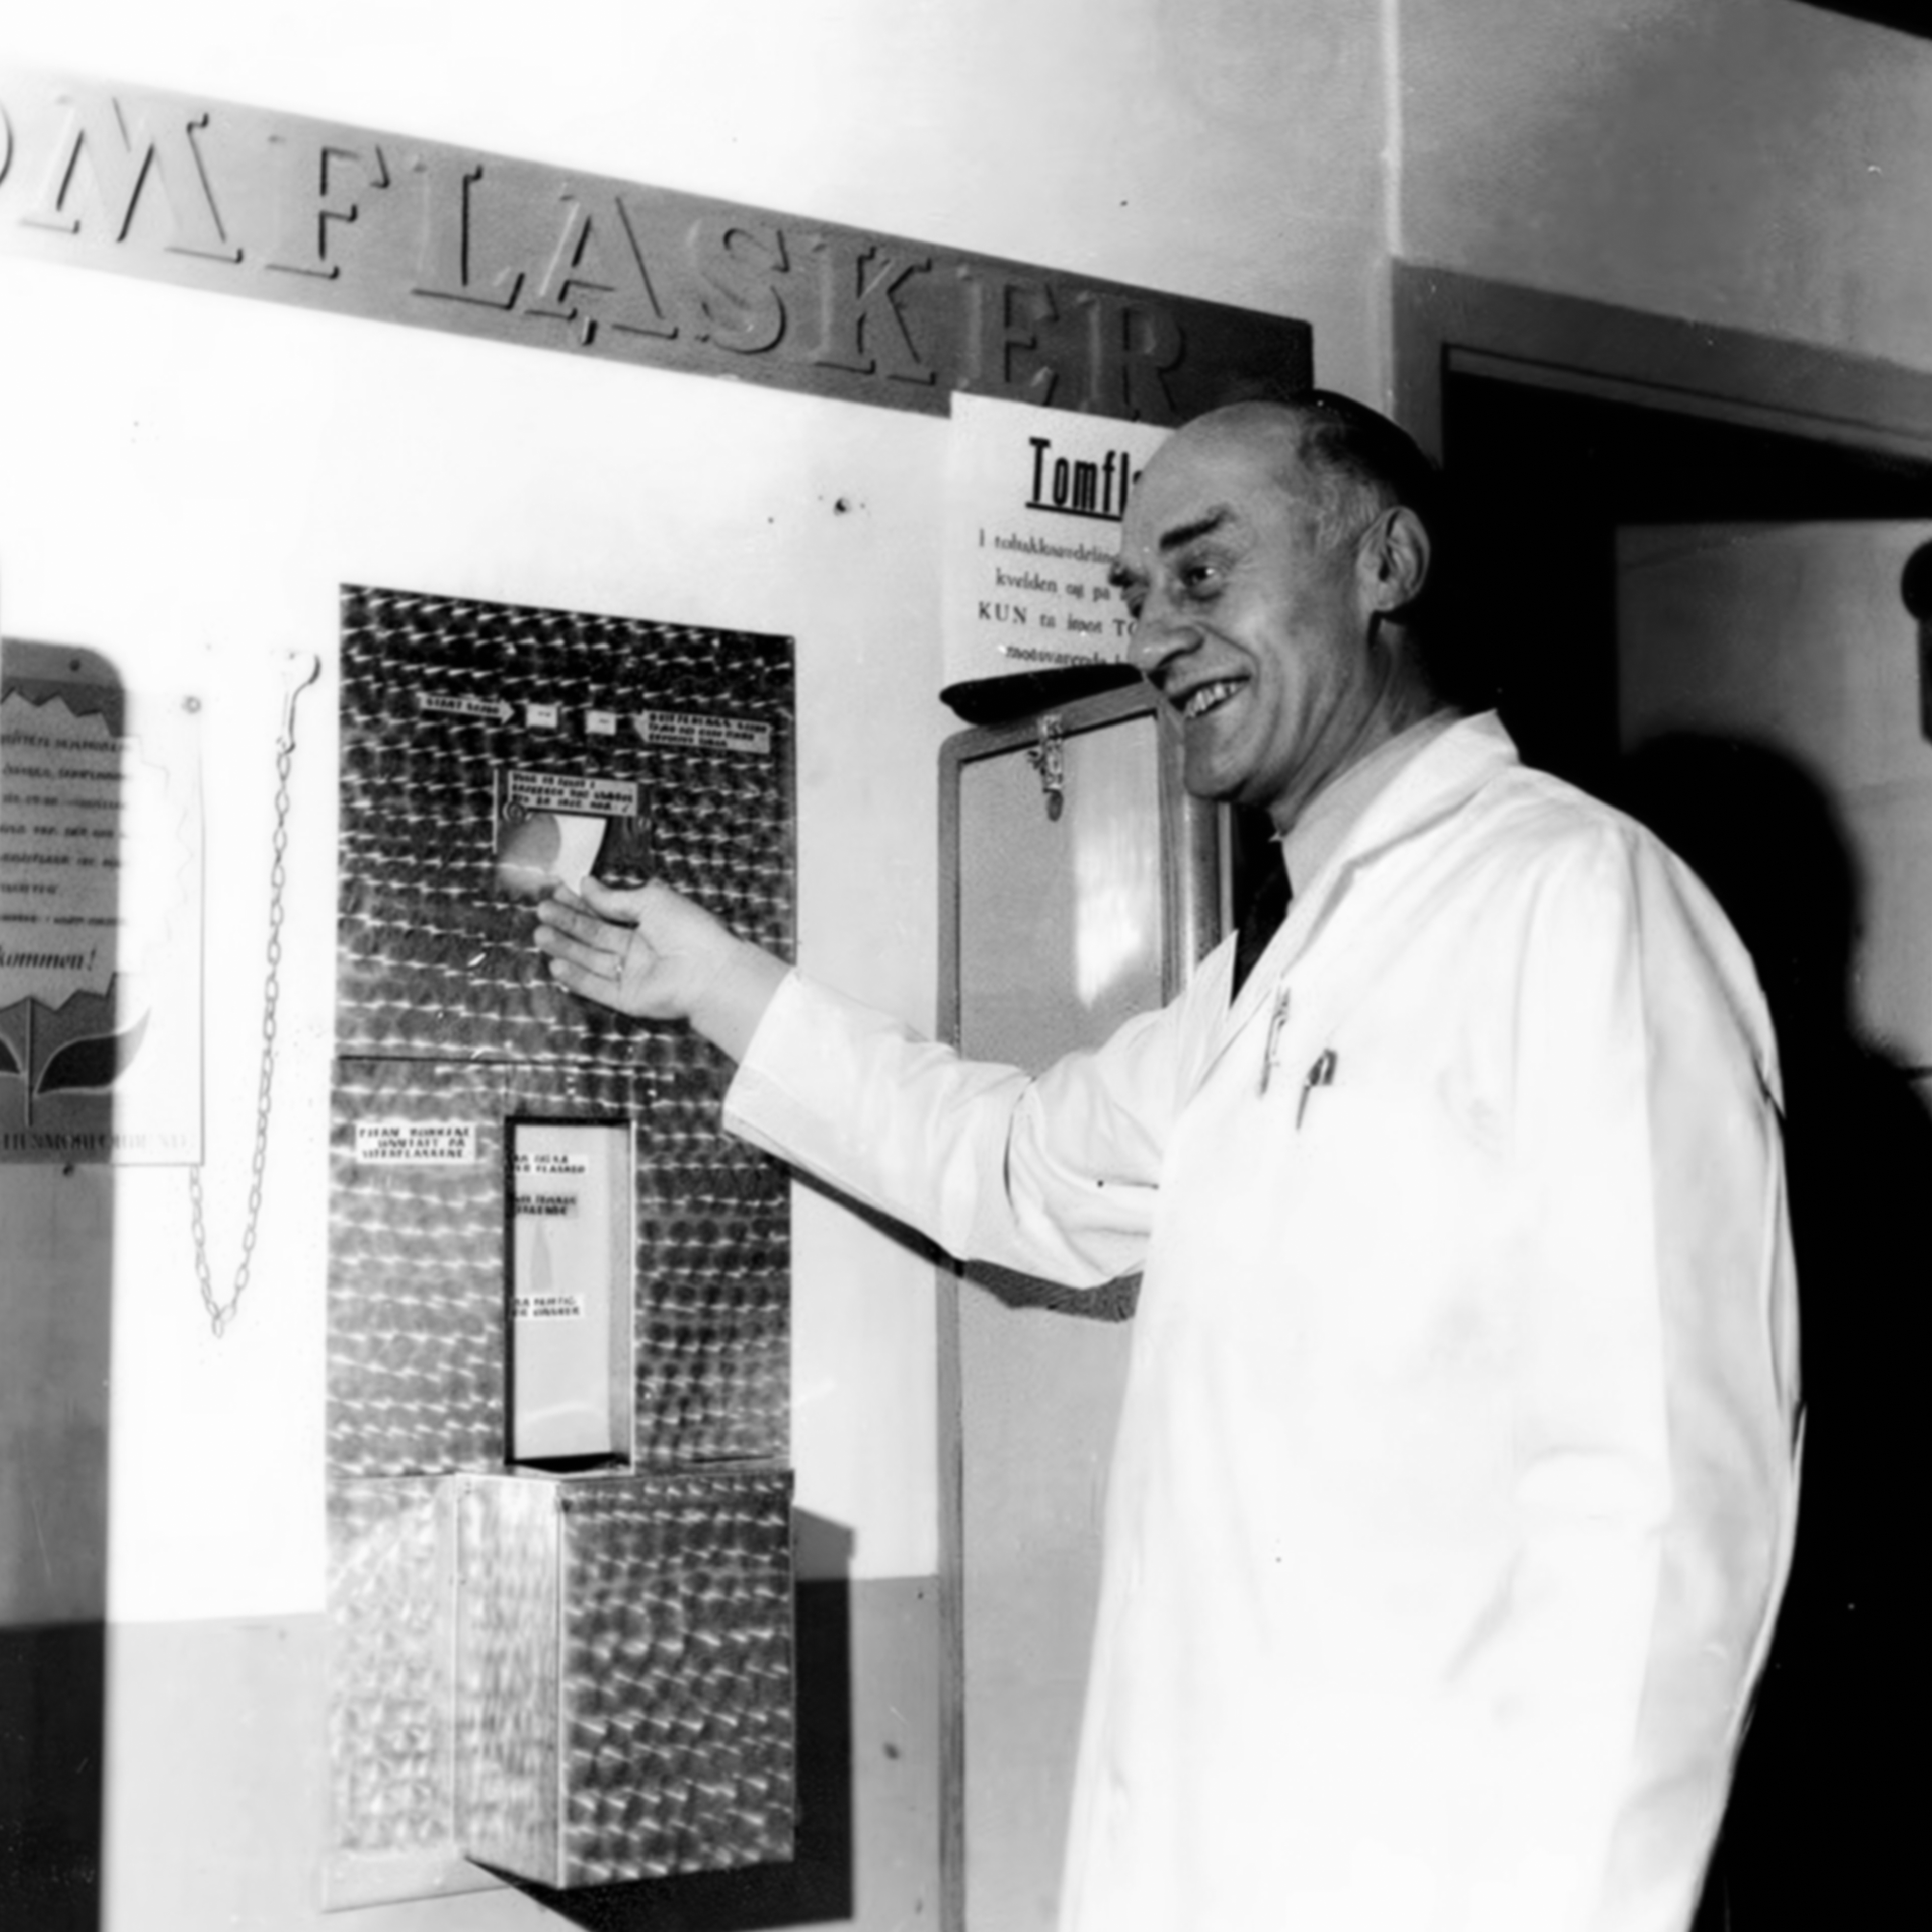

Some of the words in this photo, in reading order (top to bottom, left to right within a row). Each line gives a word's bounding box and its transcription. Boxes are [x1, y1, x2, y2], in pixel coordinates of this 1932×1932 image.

[1029, 436, 1142, 517] Tomfl
[996, 567, 1058, 592] kvelden
[1066, 583, 1084, 599] og
[979, 602, 1026, 623] KUN
